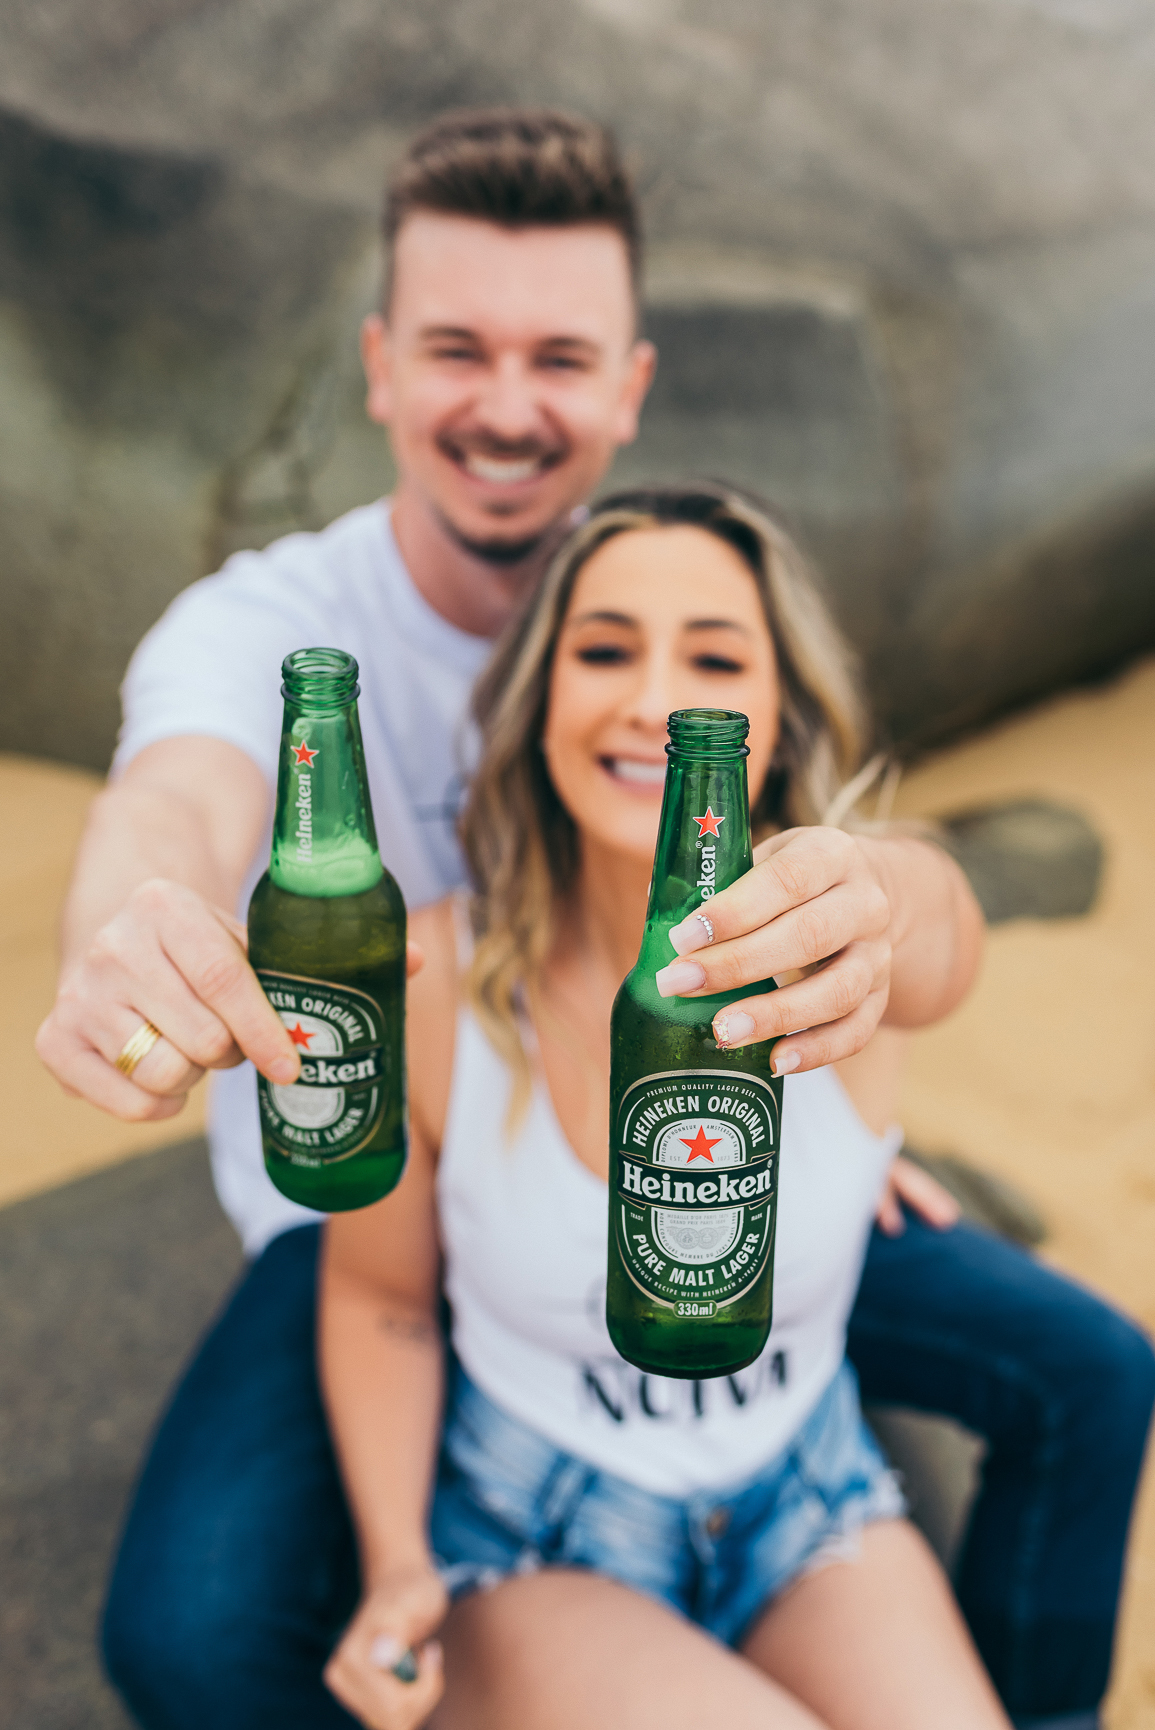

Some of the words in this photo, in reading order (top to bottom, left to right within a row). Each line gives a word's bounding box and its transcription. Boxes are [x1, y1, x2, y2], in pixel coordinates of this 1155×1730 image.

[295, 773, 312, 862] Heineken
[696, 844, 716, 906] eken
[300, 1059, 377, 1083] eken
[647, 1085, 678, 1098] PREMIUM
[681, 1083, 715, 1091] QUALITY
[717, 1083, 739, 1093] LAGER
[741, 1088, 756, 1099] BEER
[632, 1095, 700, 1147] HEINEKEN
[707, 1095, 765, 1147] ORIGINAL
[622, 1160, 771, 1204] Heineken
[633, 1234, 666, 1276] PURE
[669, 1267, 715, 1286] MALT
[720, 1232, 760, 1279] LAGER
[653, 1281, 678, 1296] RECIPE
[677, 1302, 713, 1316] 330ml
